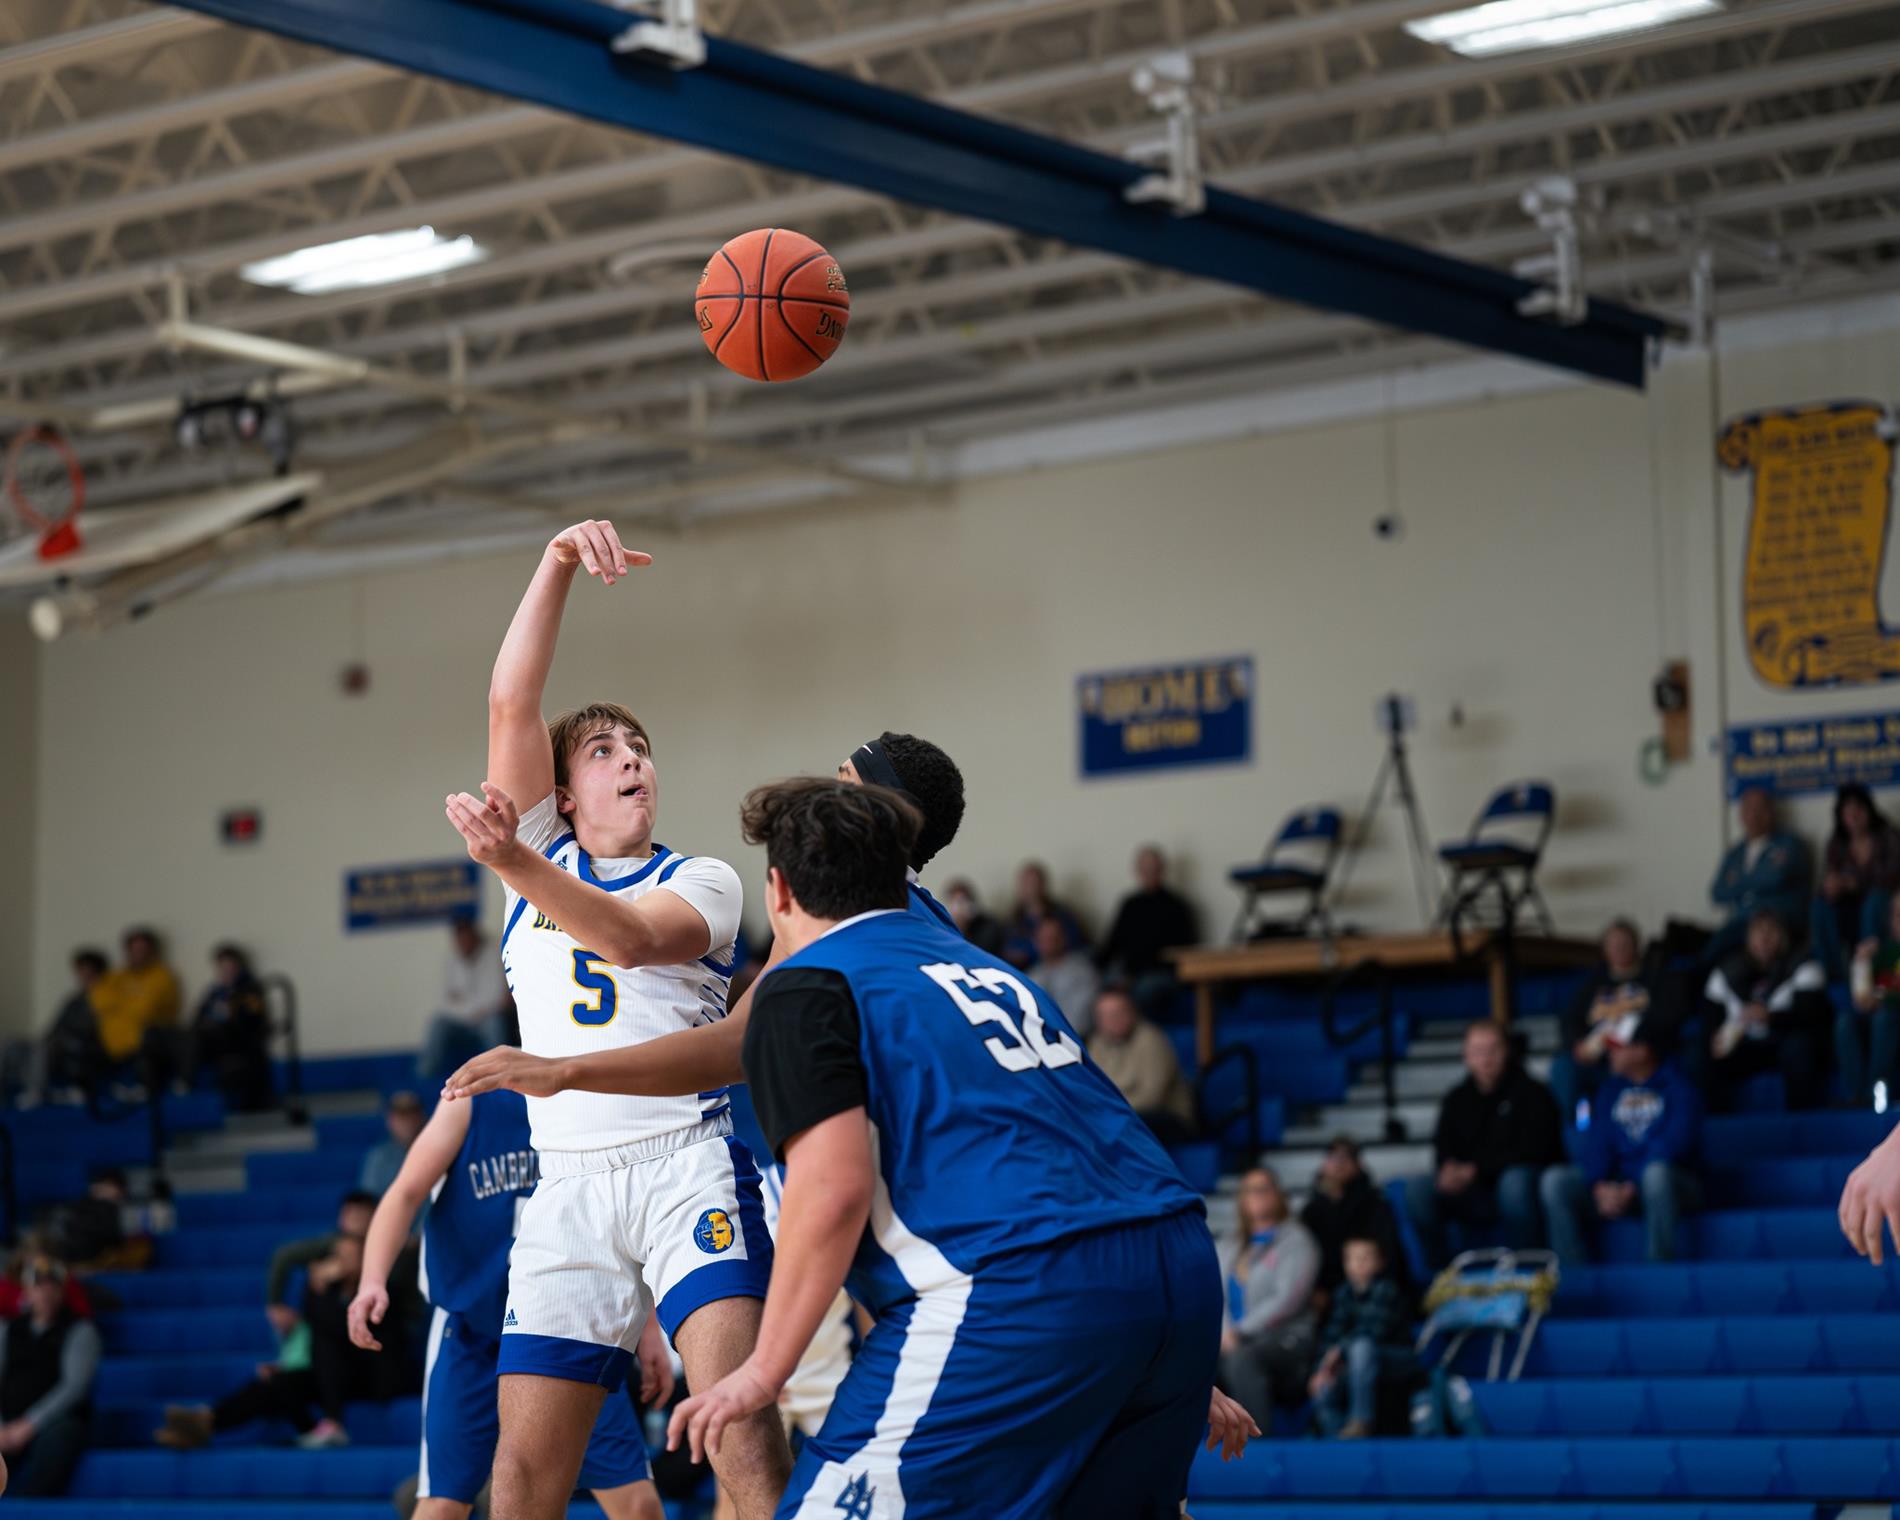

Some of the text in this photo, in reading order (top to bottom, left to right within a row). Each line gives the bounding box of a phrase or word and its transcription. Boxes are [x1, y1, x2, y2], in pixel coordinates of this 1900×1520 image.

[570, 947, 618, 1027] 5
[919, 962, 1082, 1072] 52
[469, 1151, 540, 1200] CAMBRI
